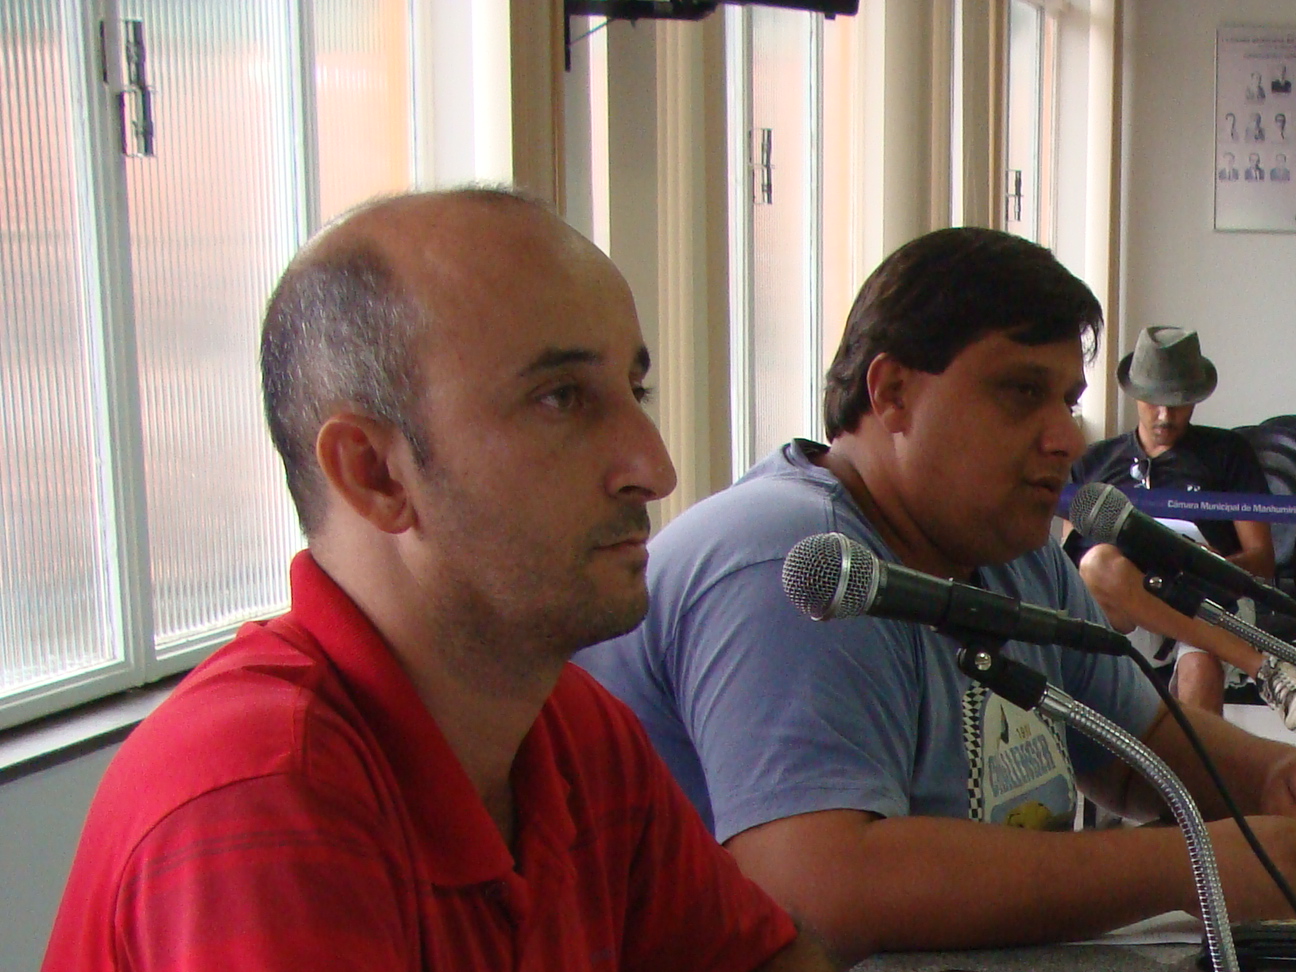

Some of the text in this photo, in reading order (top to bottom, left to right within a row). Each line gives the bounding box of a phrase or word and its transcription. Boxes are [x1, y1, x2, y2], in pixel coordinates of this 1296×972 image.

[1167, 499, 1199, 509] Câmara
[1200, 501, 1240, 512] Municipal
[1241, 503, 1252, 512] de
